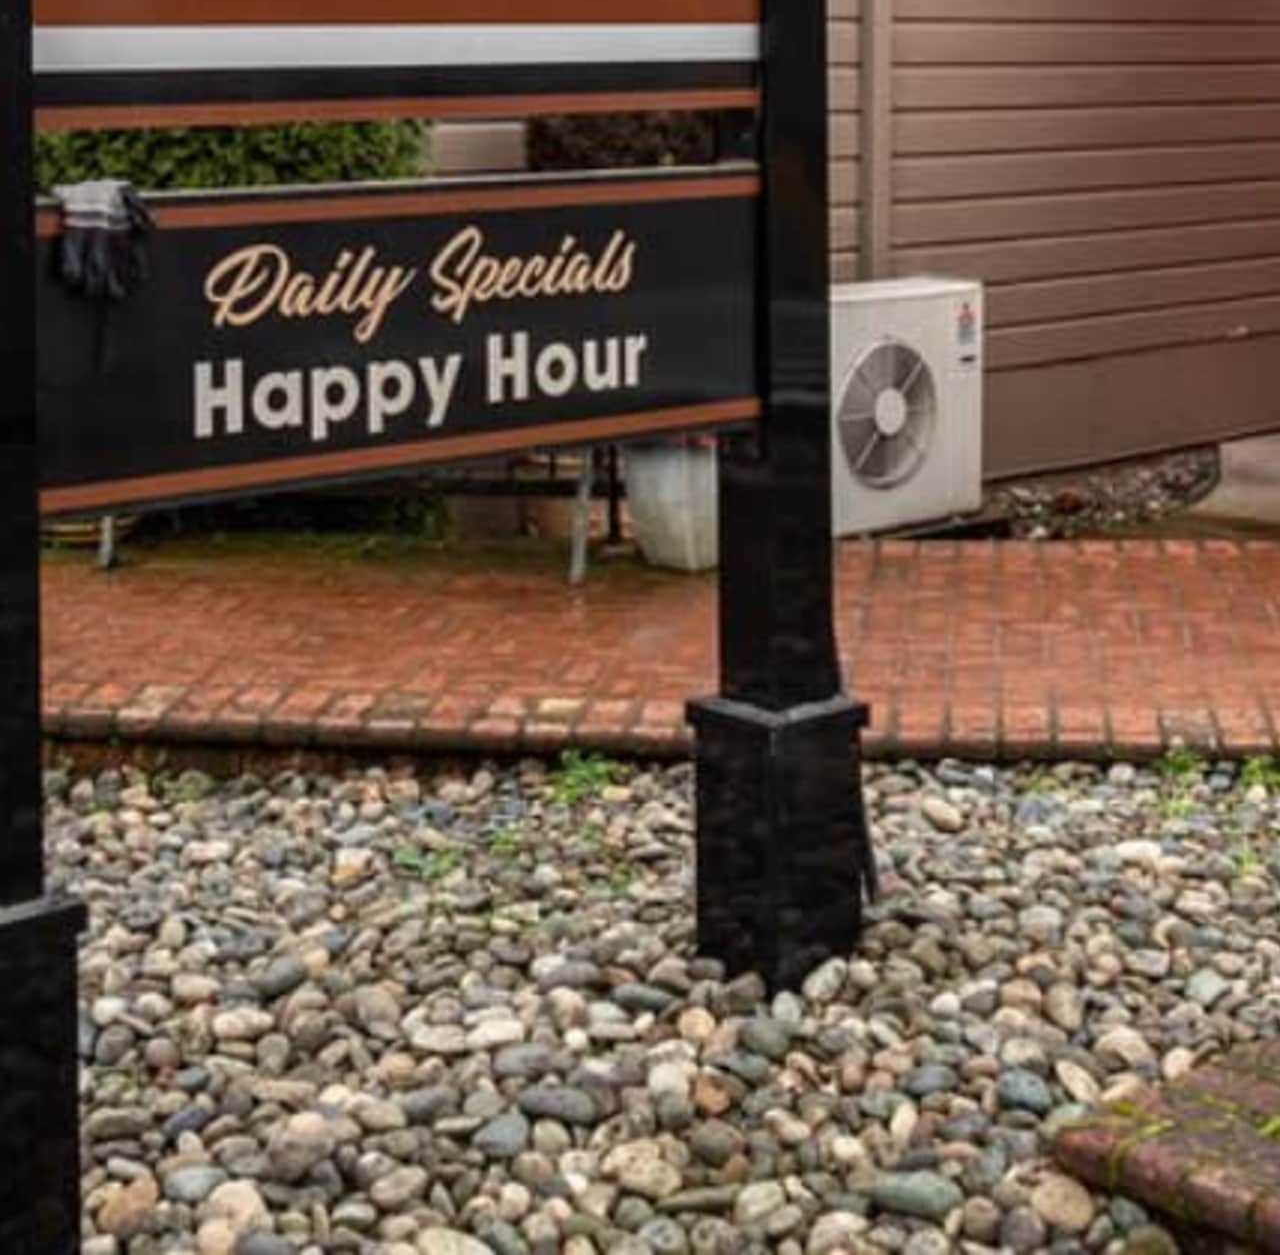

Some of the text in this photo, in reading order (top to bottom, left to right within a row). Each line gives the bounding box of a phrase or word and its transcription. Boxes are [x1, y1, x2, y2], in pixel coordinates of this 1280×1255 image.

[204, 224, 636, 342] Daily Specials
[192, 331, 648, 442] Happy Hour
